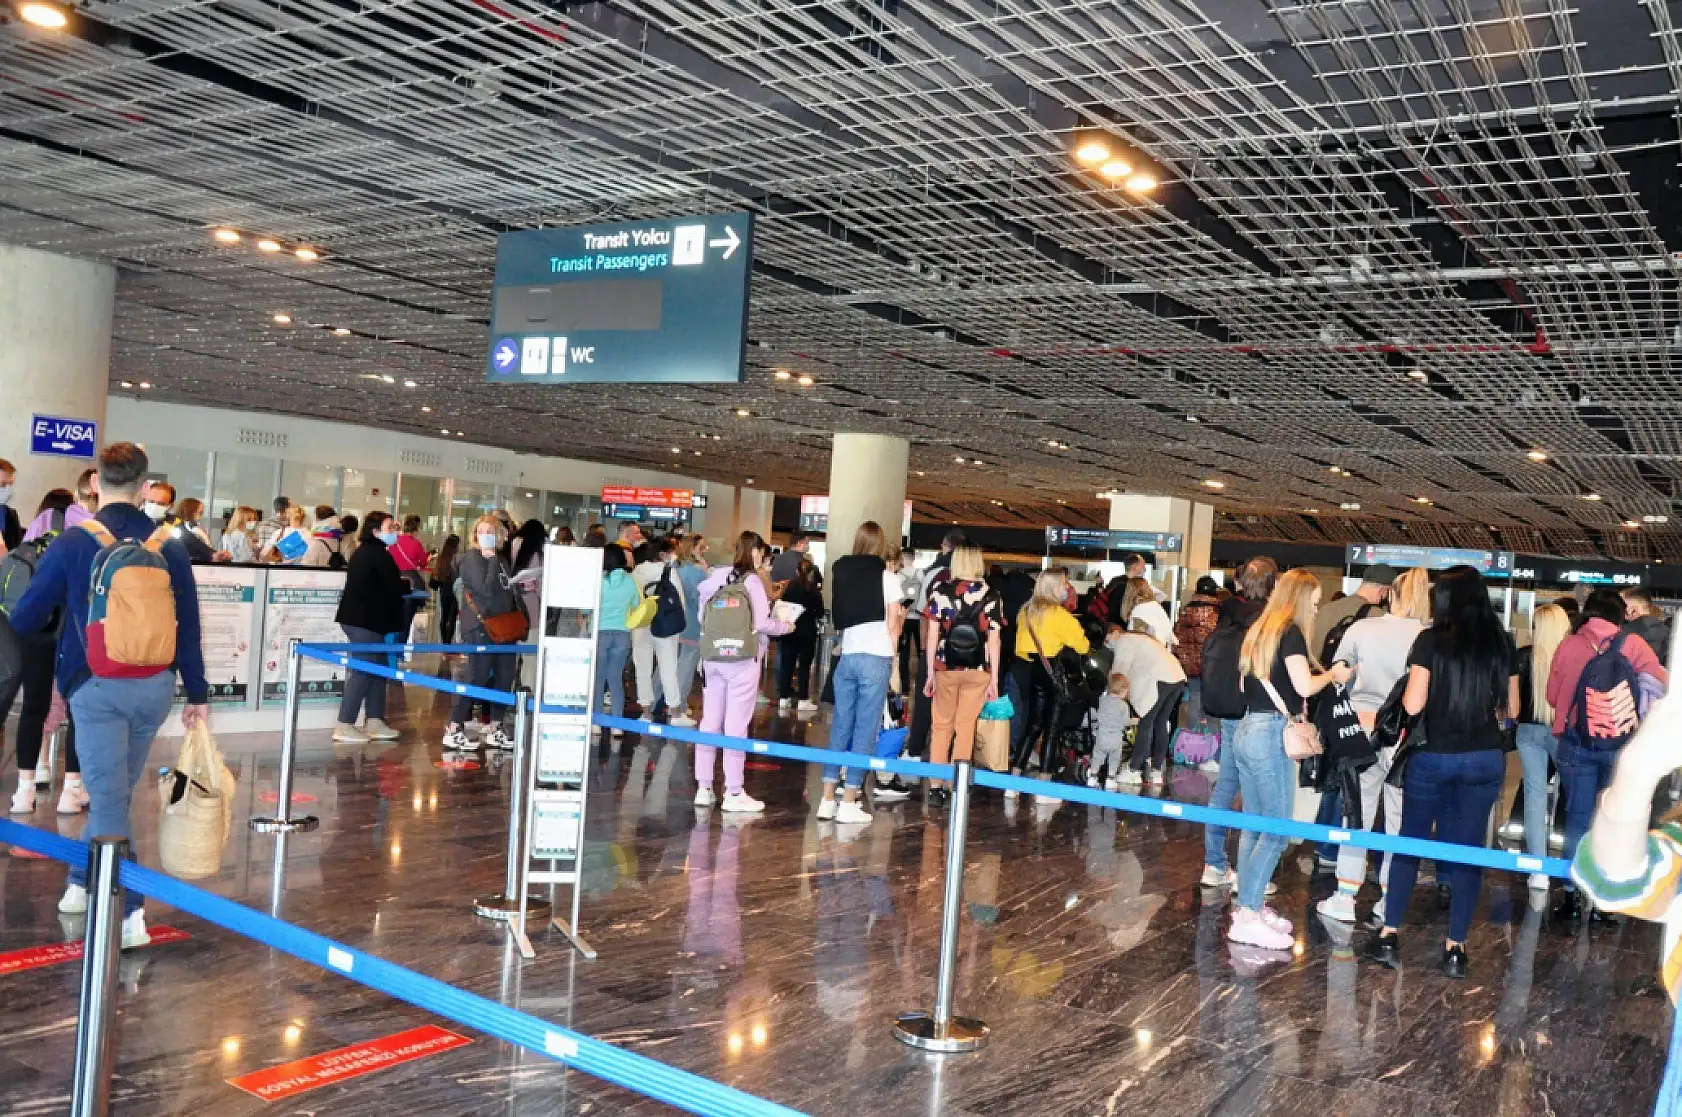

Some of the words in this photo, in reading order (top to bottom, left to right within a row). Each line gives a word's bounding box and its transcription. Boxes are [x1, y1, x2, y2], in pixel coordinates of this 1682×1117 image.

[584, 231, 629, 250] Transit
[632, 228, 670, 247] Yolcu
[550, 256, 593, 272] Transit
[595, 253, 668, 271] Passengers
[571, 347, 595, 363] WC
[34, 422, 94, 442] E-VISA
[1051, 530, 1058, 541] 5
[1352, 547, 1361, 559] 7
[1497, 556, 1507, 568] 8
